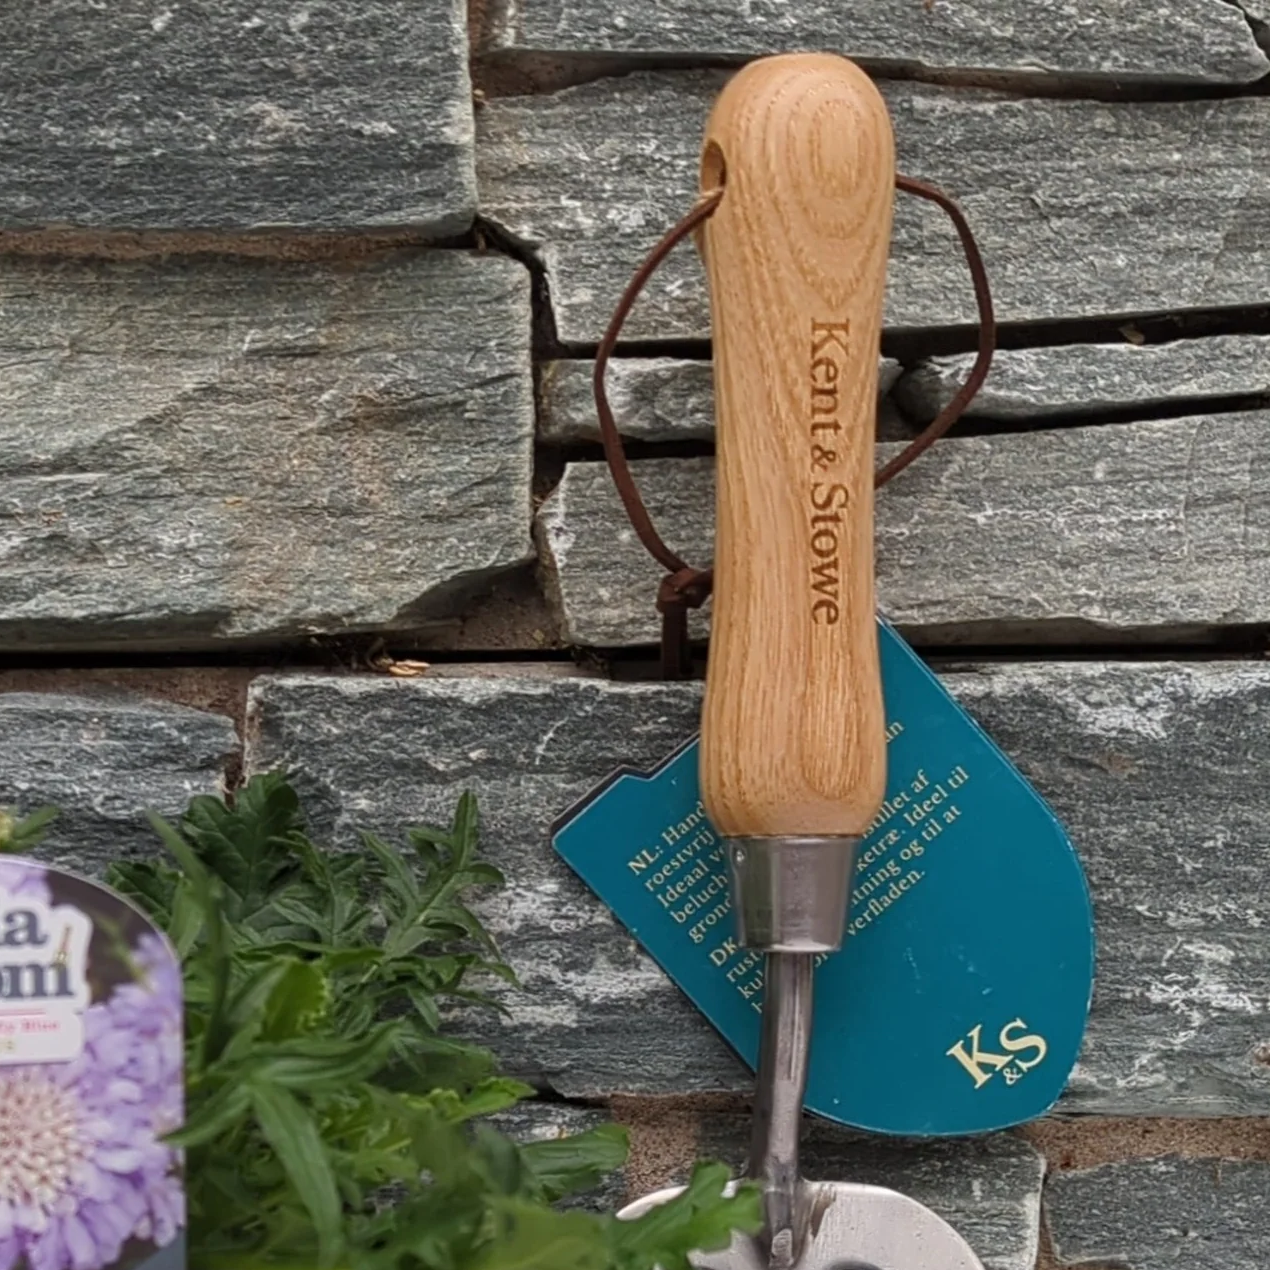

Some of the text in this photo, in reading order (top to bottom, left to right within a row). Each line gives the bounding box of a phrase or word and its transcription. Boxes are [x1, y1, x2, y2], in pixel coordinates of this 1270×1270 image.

[810, 317, 850, 626] Kent & Stowe
[911, 769, 930, 793] af
[627, 845, 663, 876] NL:
[644, 827, 716, 892] roestvrij
[656, 859, 708, 908] Ideaal
[726, 951, 764, 983] rust
[903, 785, 949, 827] Ideel
[947, 766, 970, 790] til
[851, 804, 962, 908] tning og til at
[670, 873, 729, 924] beluch
[847, 869, 926, 937] verfladen.
